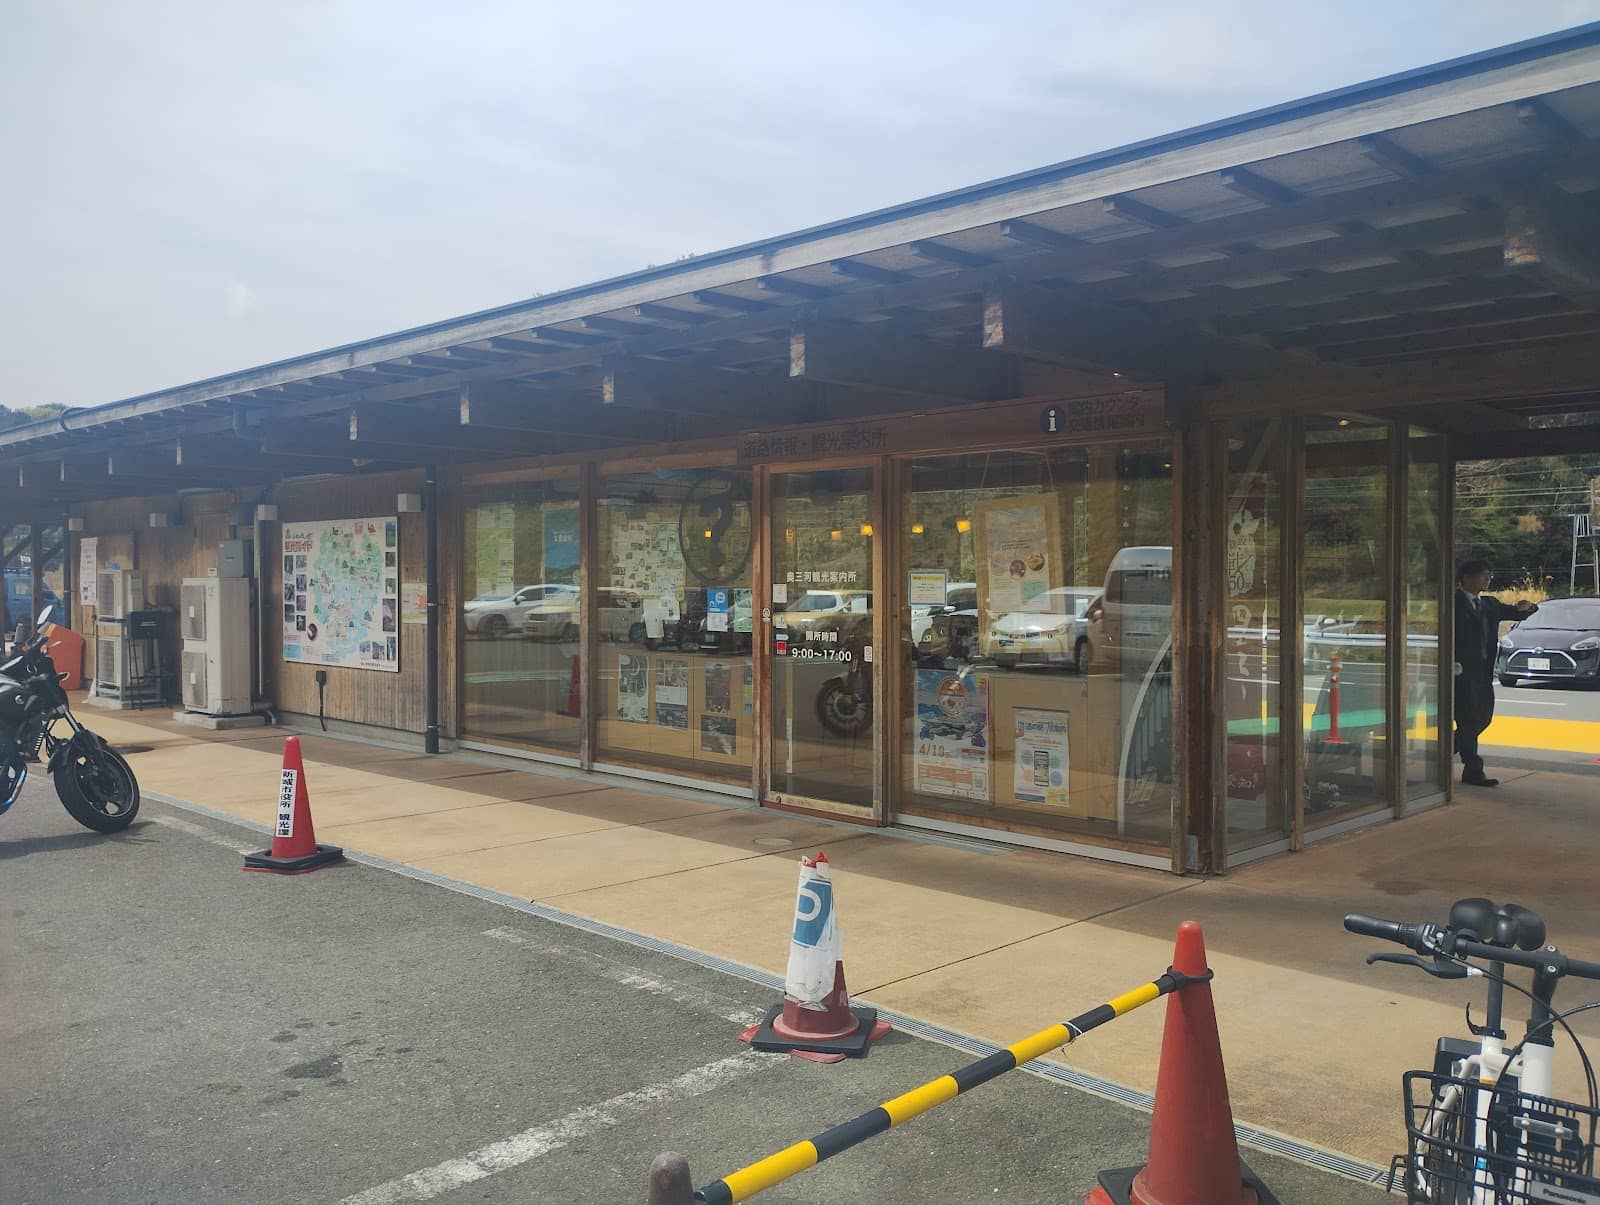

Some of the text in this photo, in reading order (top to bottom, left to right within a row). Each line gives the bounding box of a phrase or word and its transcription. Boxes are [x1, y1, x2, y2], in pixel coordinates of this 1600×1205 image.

[786, 571, 857, 583] 奥三河観光案内所
[805, 630, 838, 642] 開所時間
